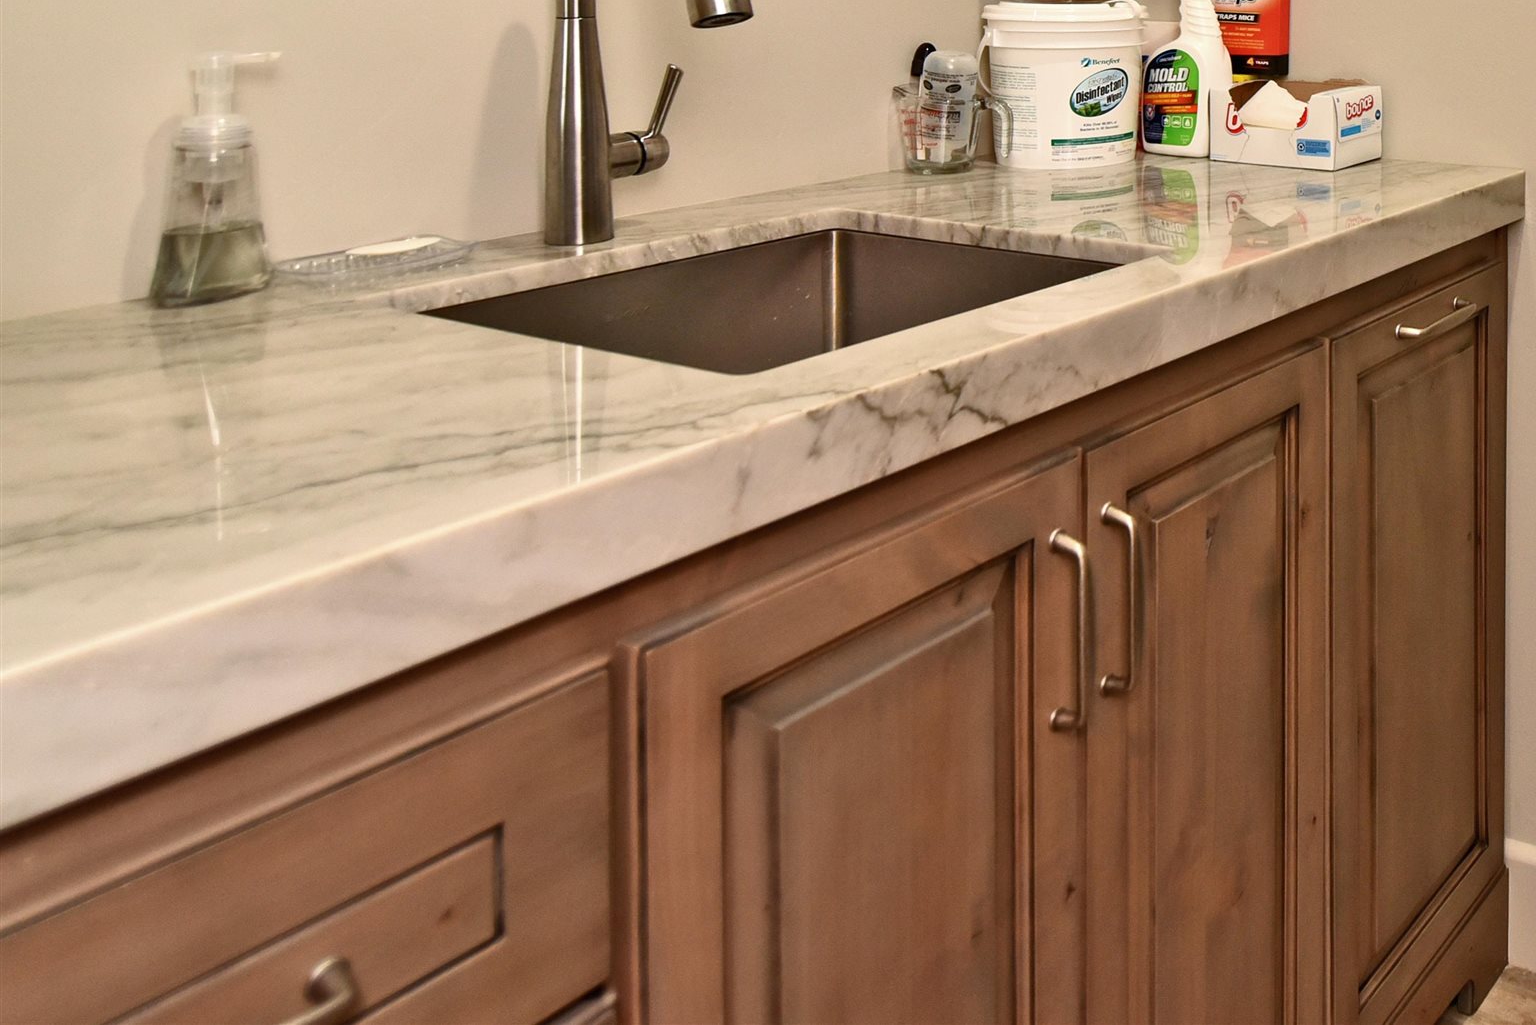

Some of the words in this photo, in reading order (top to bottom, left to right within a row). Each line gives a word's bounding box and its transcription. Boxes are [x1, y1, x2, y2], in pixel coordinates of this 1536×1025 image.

[1246, 57, 1254, 66] 4
[1149, 67, 1189, 82] MOLD
[1076, 76, 1124, 104] Disinfectant
[1147, 82, 1189, 93] CONTROL
[1346, 95, 1374, 120] bounce
